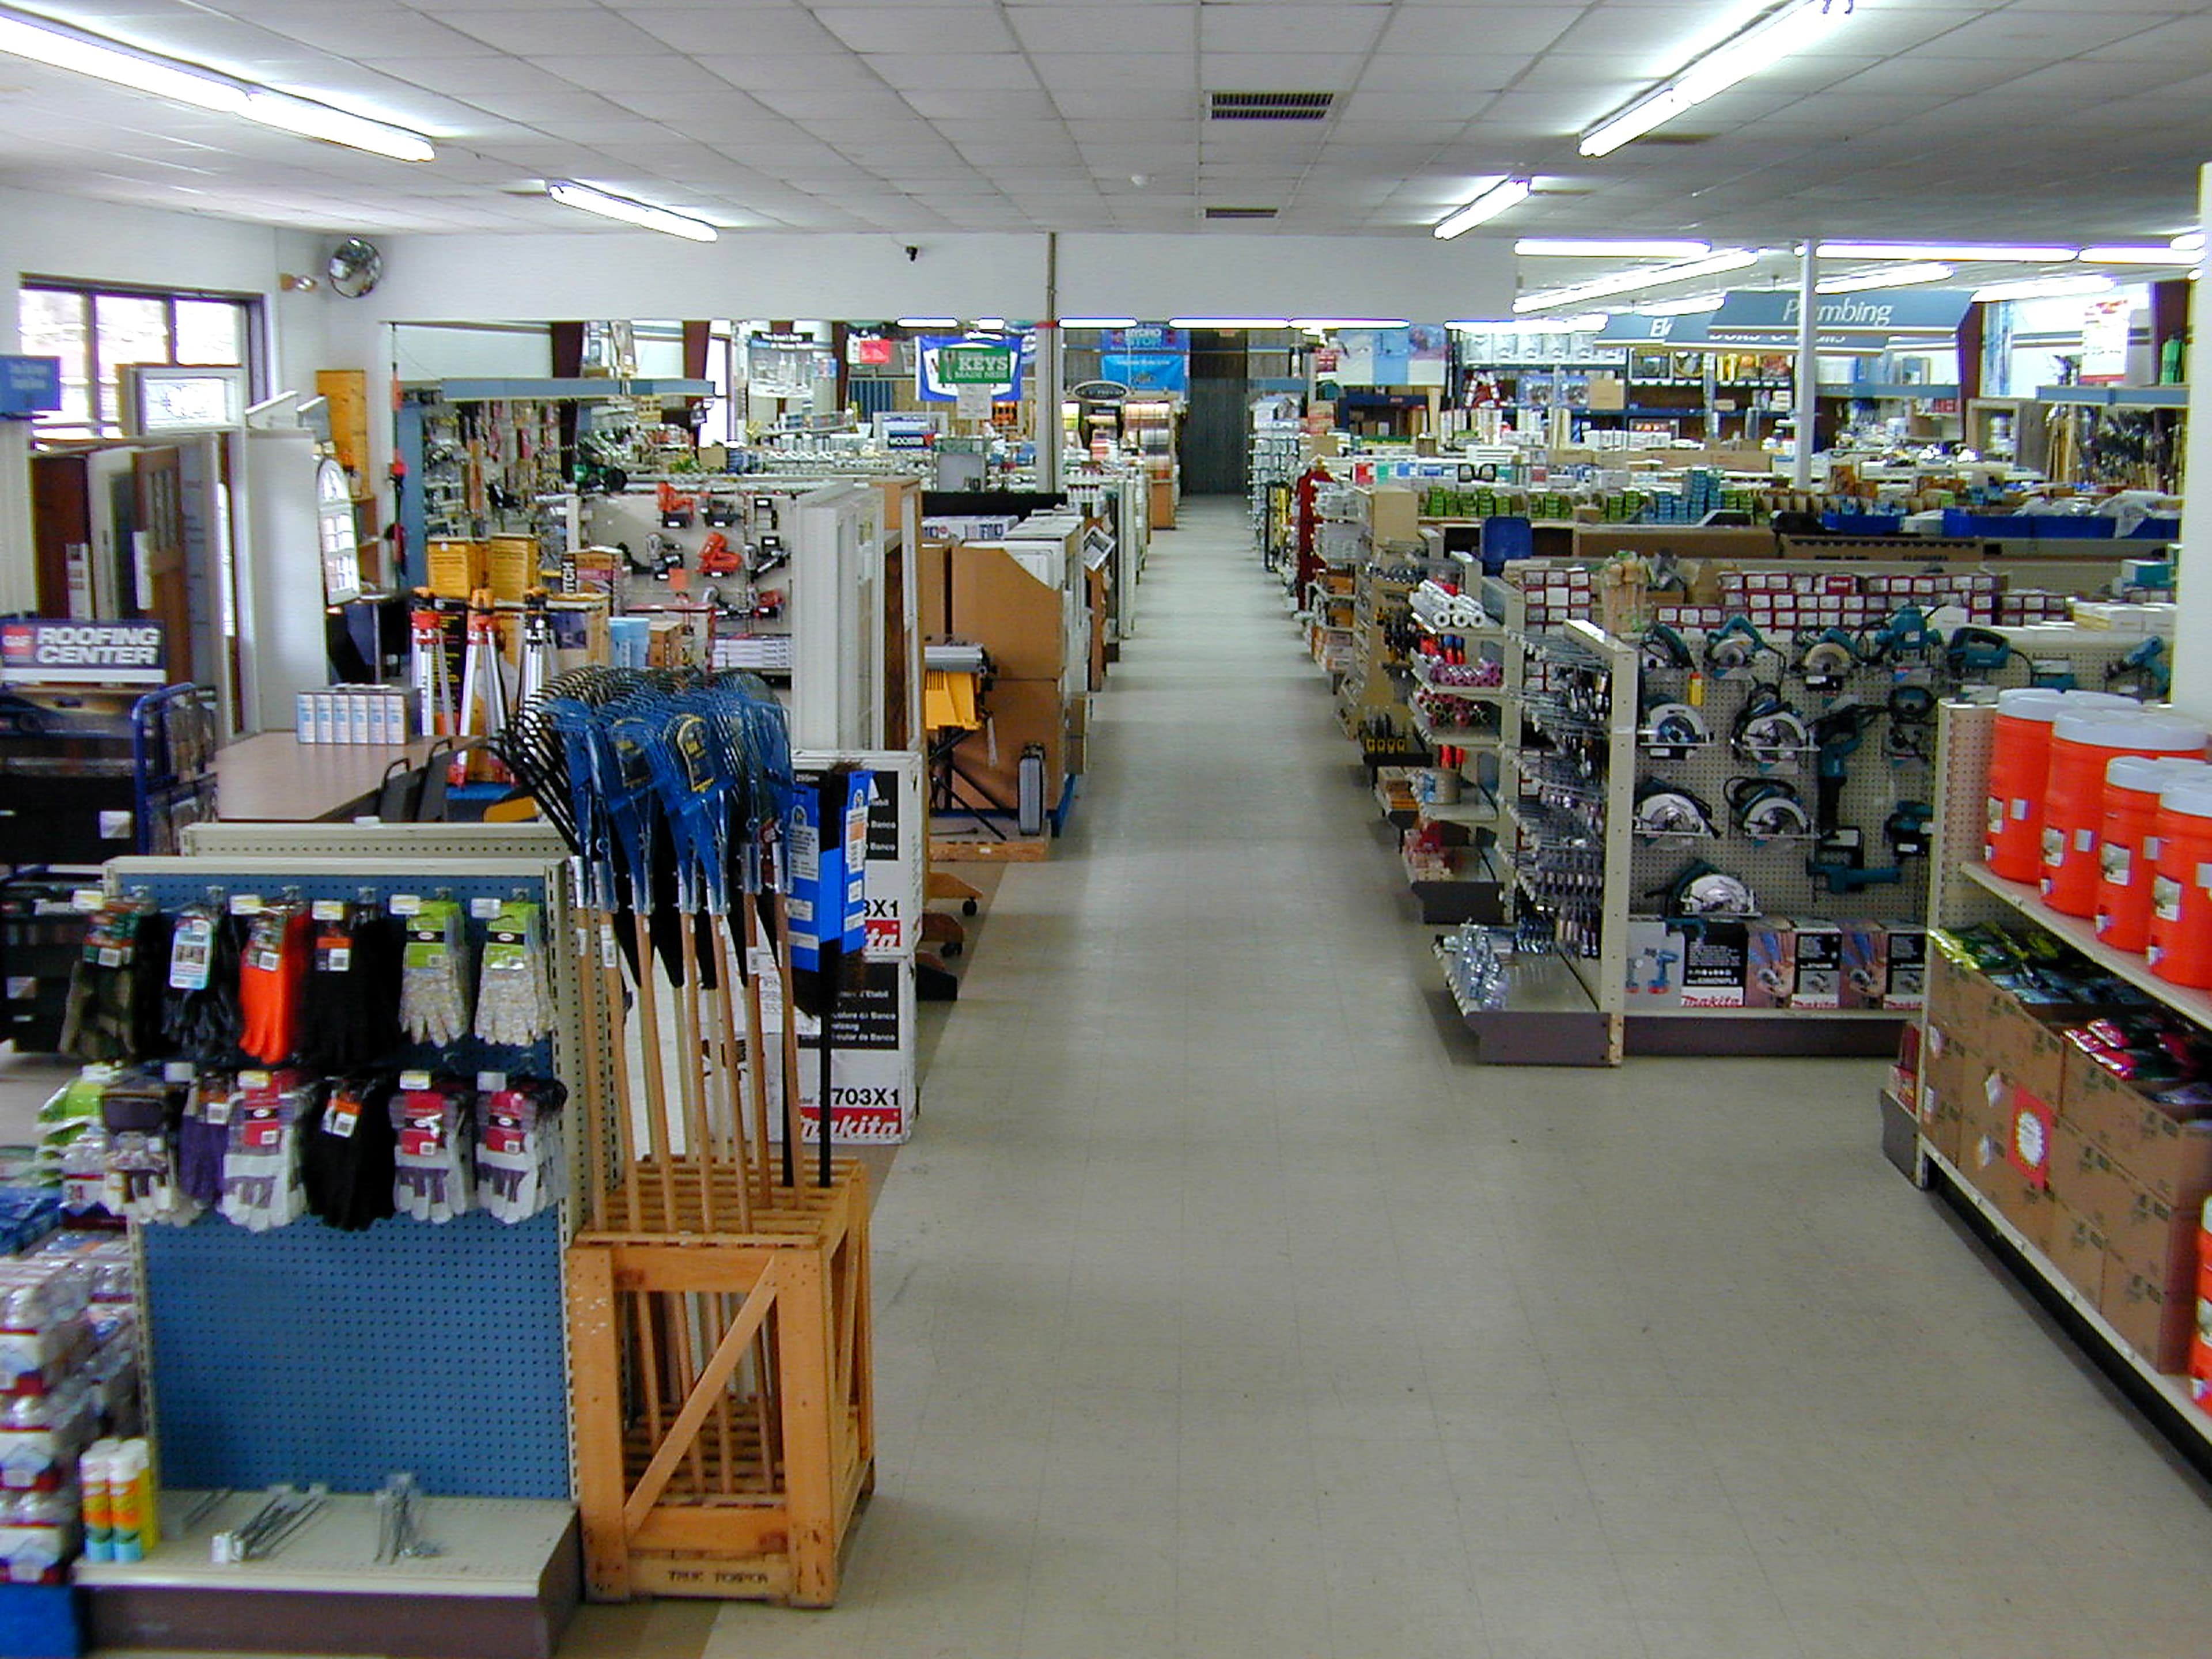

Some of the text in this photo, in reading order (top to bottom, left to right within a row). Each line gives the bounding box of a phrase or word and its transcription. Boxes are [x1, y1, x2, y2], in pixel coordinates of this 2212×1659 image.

[1782, 297, 1893, 327] Pmbing
[958, 357, 1008, 371] KEYS
[36, 626, 161, 646] ROOFING
[36, 646, 158, 664] CENTER
[863, 899, 897, 918] 3X1
[831, 1088, 899, 1106] 703X1
